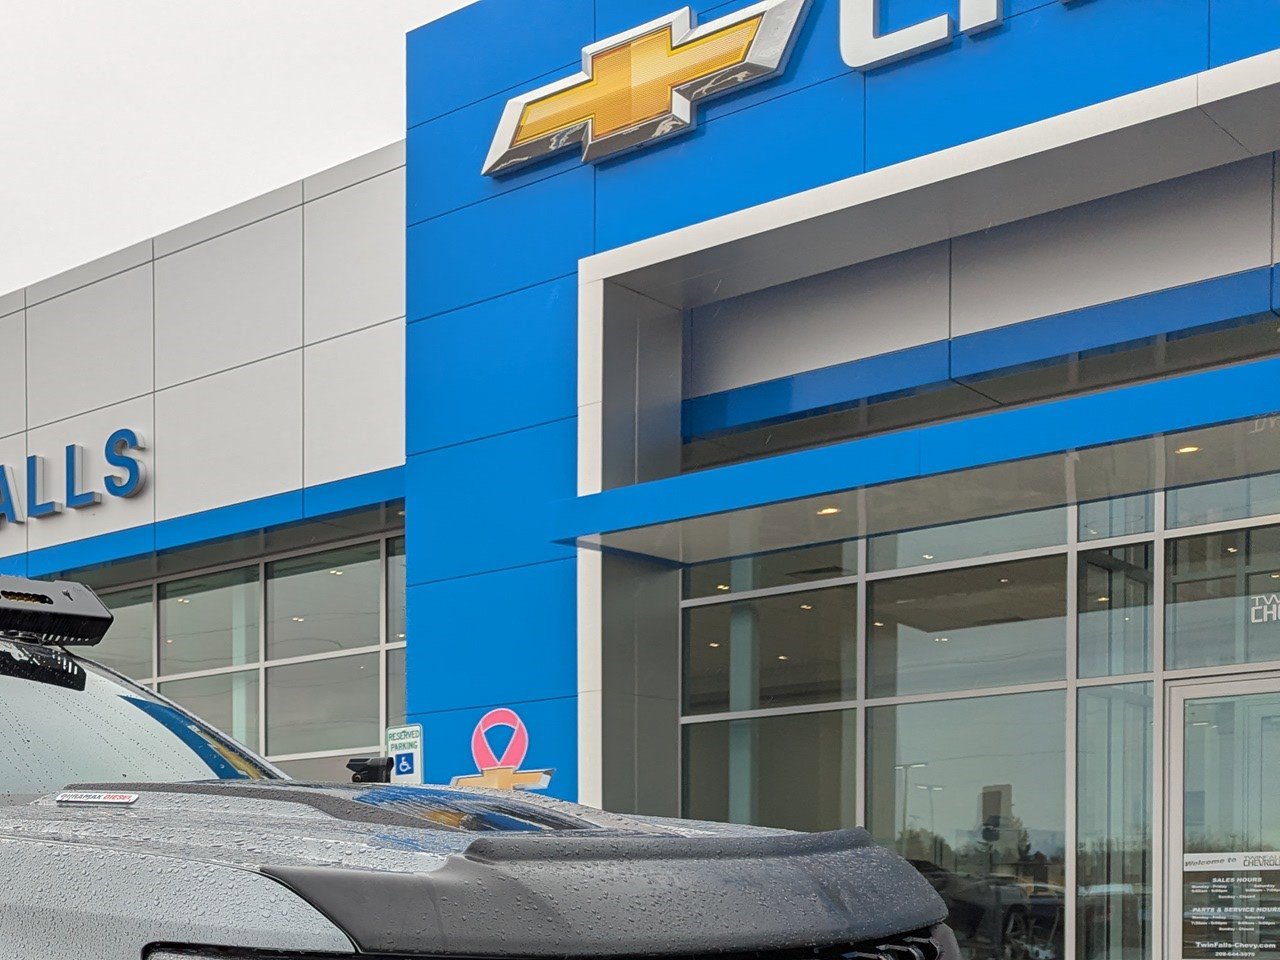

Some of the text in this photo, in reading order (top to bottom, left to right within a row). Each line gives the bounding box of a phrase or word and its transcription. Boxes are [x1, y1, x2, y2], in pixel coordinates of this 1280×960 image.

[388, 730, 420, 741] RESERVED
[390, 741, 418, 752] PARKING
[103, 793, 133, 801] DIESEL
[1185, 858, 1225, 867] Welcome
